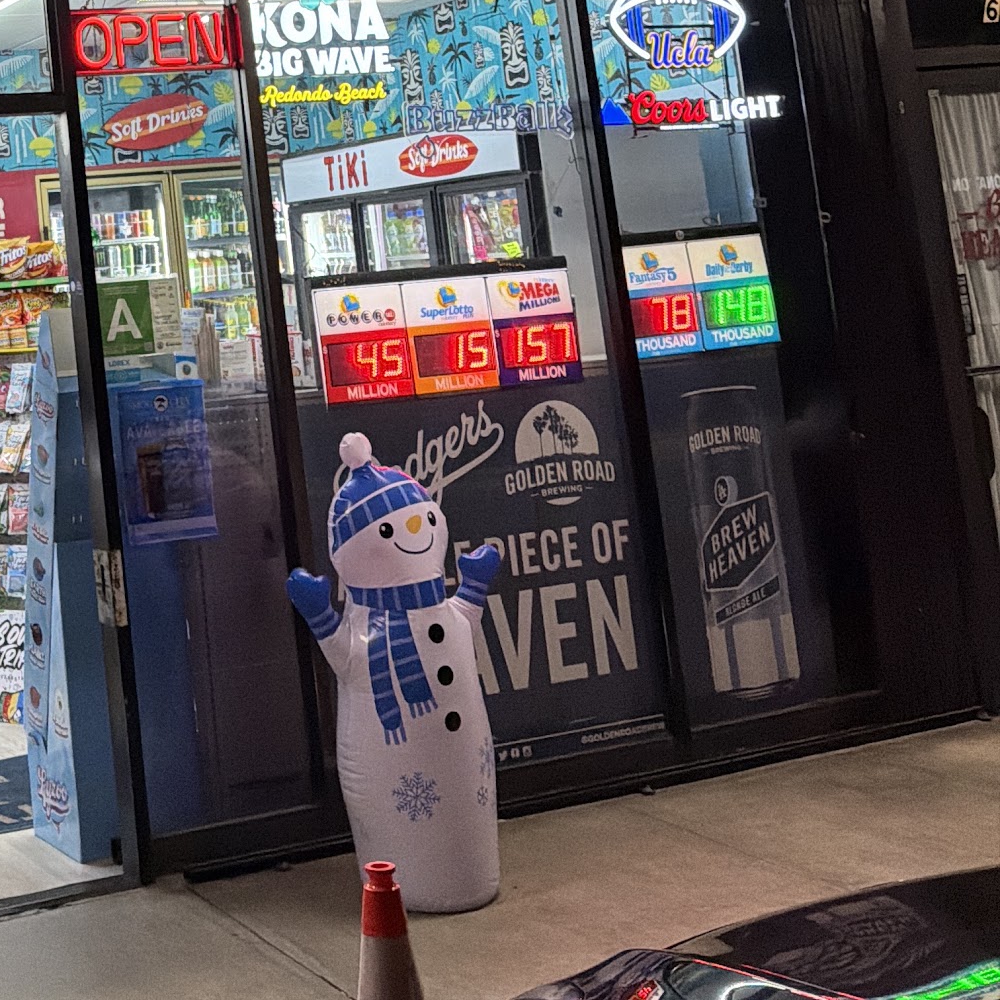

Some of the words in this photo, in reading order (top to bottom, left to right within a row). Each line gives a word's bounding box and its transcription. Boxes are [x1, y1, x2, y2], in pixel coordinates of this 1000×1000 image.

[986, 0, 999, 21] 6
[75, 11, 225, 70] OPEN
[306, 45, 395, 75] WAVE
[259, 83, 332, 107] Redondo
[334, 81, 387, 105] Beach
[628, 90, 710, 125] Coors
[709, 95, 782, 122] LIGHT
[110, 116, 143, 143] Soft
[147, 103, 204, 129] Drinks
[519, 281, 560, 301] MEGA
[716, 284, 768, 326] 148
[106, 297, 143, 342] A
[651, 294, 692, 331] 78
[457, 331, 489, 369] 15
[516, 323, 570, 363] 157
[635, 333, 697, 352] THOUSAND
[711, 325, 774, 343] THOUSAND
[356, 339, 403, 378] 45
[518, 364, 567, 381] MILLION
[346, 382, 399, 400] MILLION
[435, 374, 485, 390] MILLION
[688, 426, 731, 453] GOLDEN
[733, 425, 762, 445] ROAD
[504, 464, 569, 496] GOLDEN
[572, 459, 617, 484] ROAD
[540, 483, 584, 498] BREWING
[591, 518, 630, 564] OF
[710, 503, 757, 555] BREW
[708, 521, 771, 584] HEAVEN
